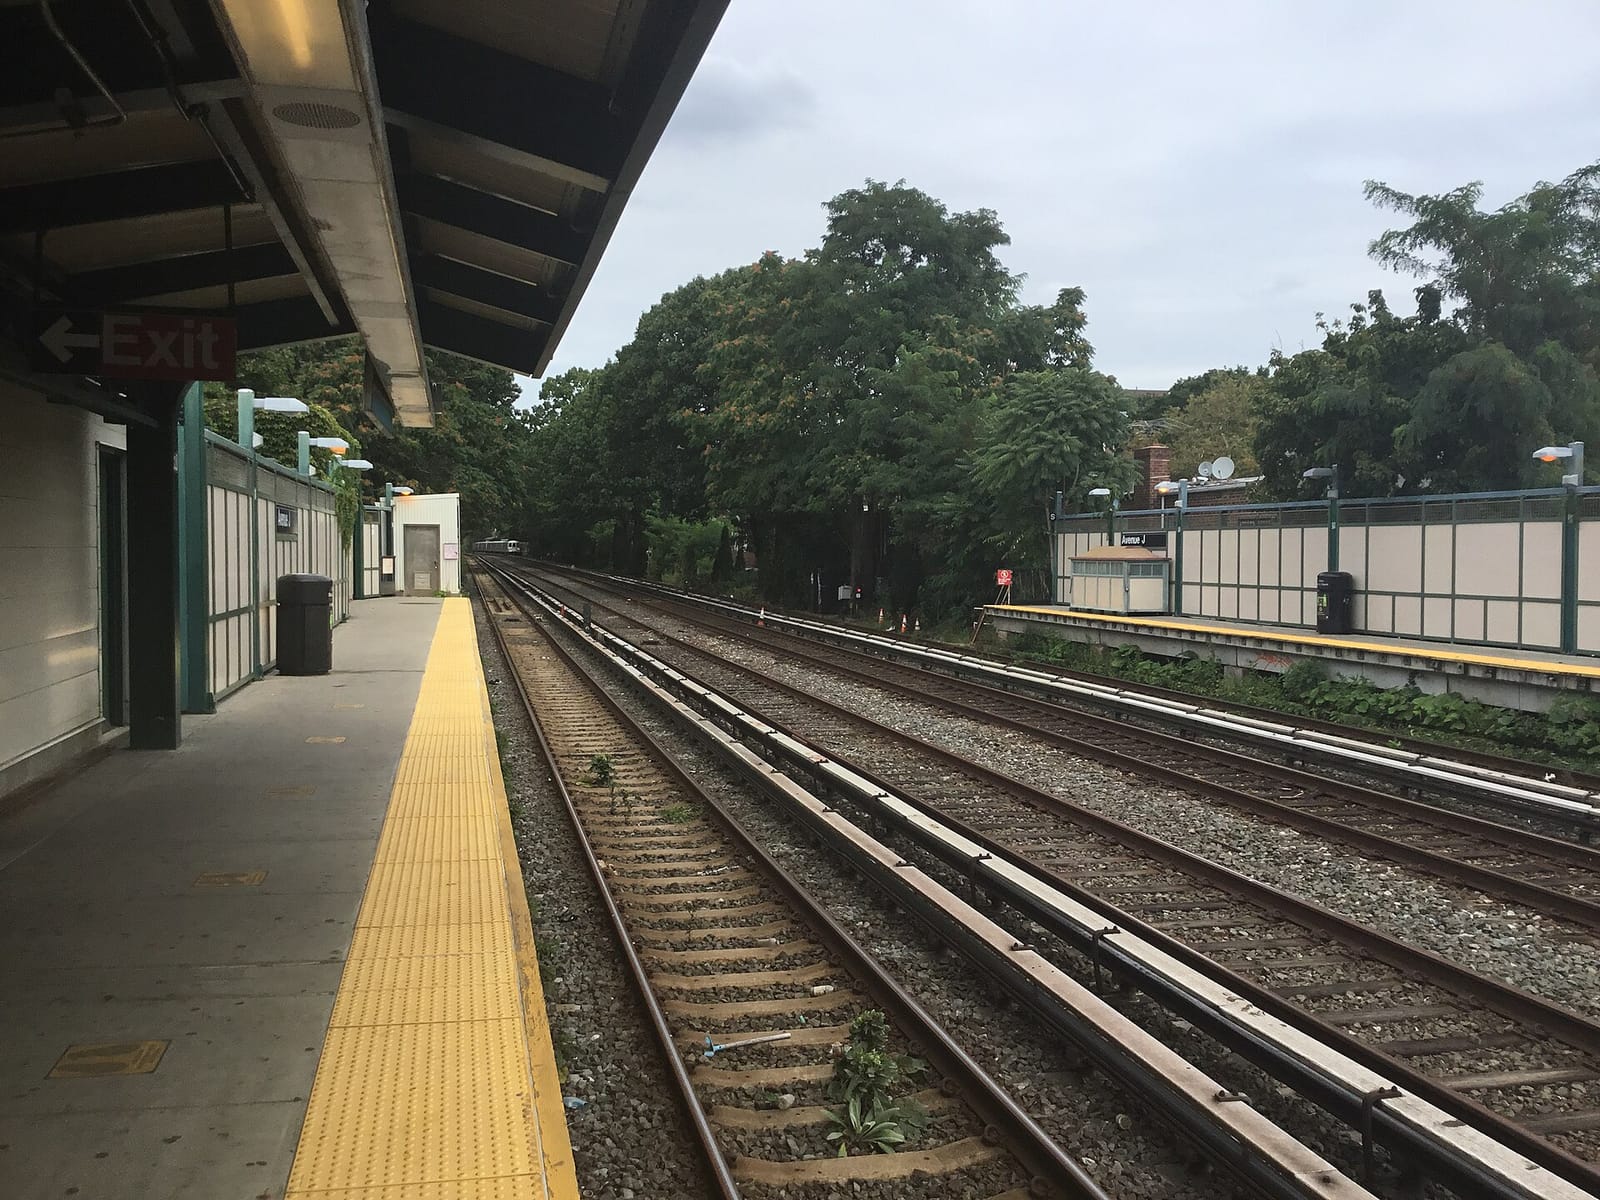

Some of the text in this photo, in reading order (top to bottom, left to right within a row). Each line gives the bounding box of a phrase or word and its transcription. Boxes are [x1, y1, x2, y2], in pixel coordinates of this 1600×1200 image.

[102, 313, 219, 371] Exit
[1050, 513, 1056, 521] S
[1121, 534, 1146, 545] Avenue J
